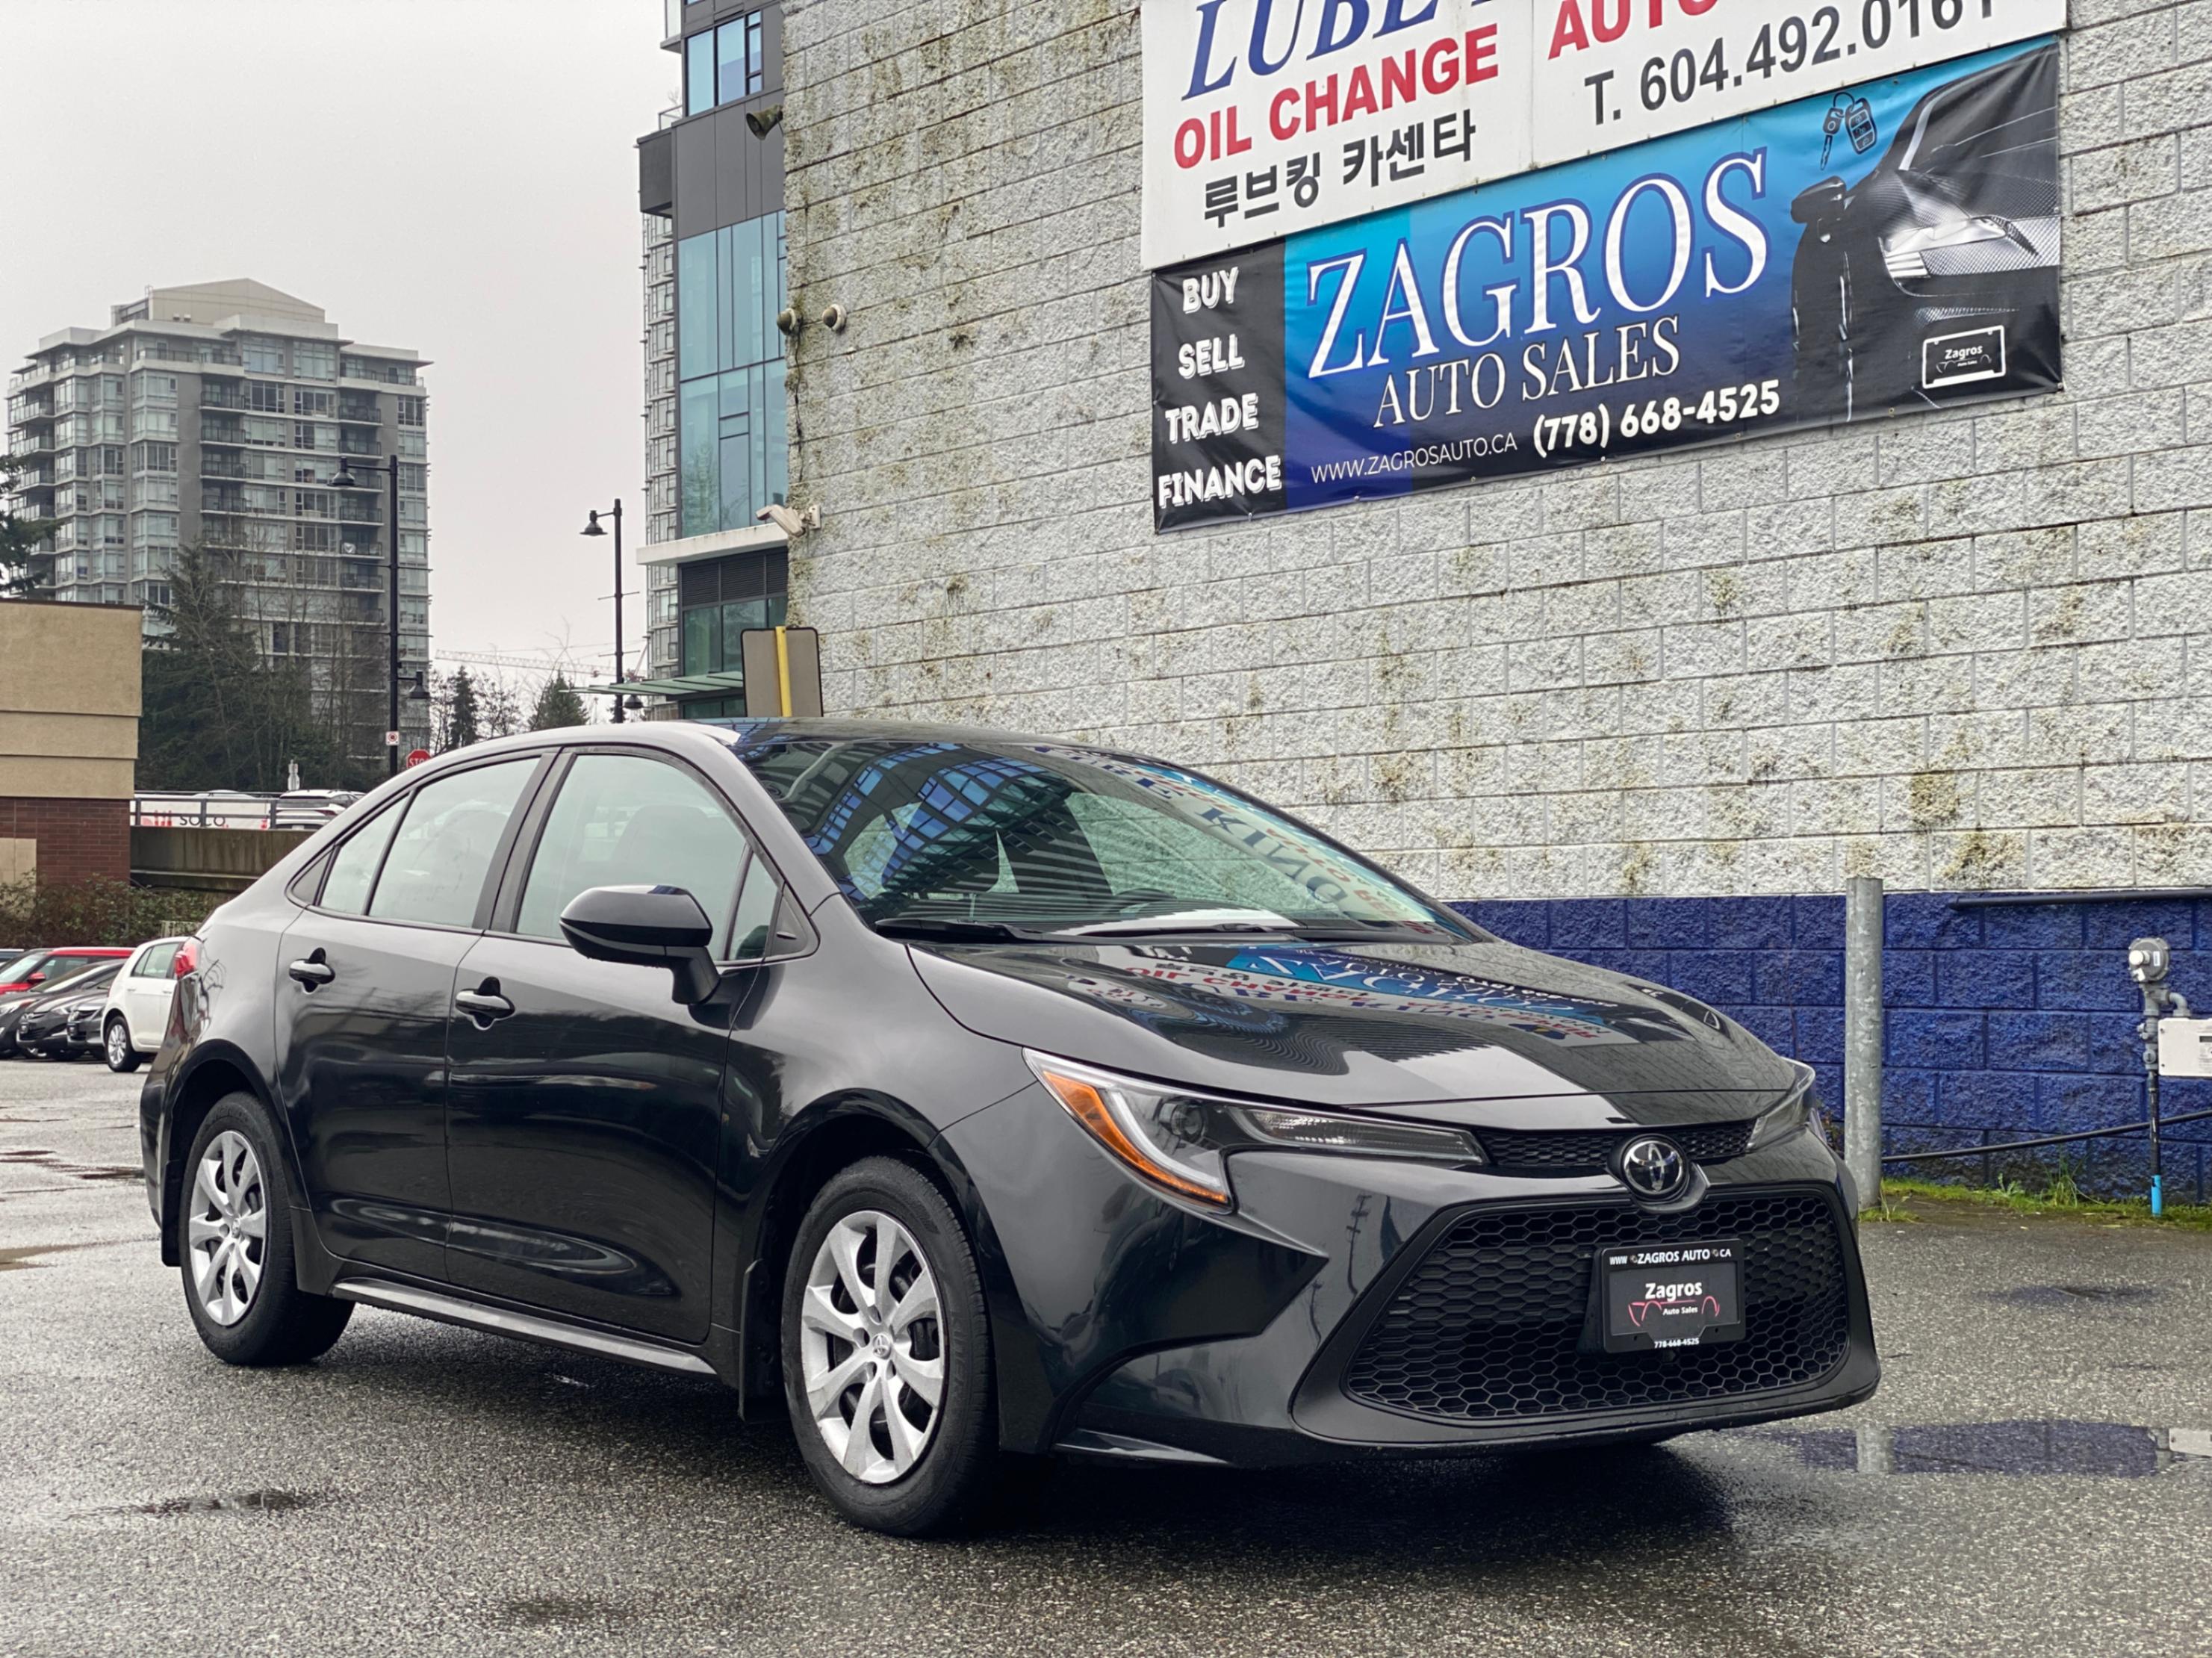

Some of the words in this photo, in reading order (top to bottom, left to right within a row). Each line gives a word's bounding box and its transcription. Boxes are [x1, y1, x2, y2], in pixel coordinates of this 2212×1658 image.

[1547, 0, 1718, 60] AU
[1175, 106, 1252, 169] OIL
[1269, 23, 1499, 140] CHANGE
[1585, 69, 1621, 125] T.
[1205, 152, 1320, 228] 루브킹
[1343, 109, 1476, 187] 카센타
[1182, 267, 1240, 314] BUY
[1307, 149, 1769, 379] ZAGROS
[1178, 334, 1245, 379] SELL
[1373, 353, 1506, 428] AUTO
[1521, 316, 1680, 401] SALES
[1945, 346, 1983, 360] Zagros
[1165, 393, 1259, 444] TRADE
[1533, 403, 1610, 459] (778)
[1620, 379, 1780, 438] 668-4525
[1158, 454, 1282, 508] FINANCE
[1311, 432, 1517, 484] WWW.ZAGROSAUTO.CA
[409, 758, 429, 769] ST
[1637, 1251, 1680, 1264] ZAGROS
[1681, 1249, 1710, 1261] AUTO
[1720, 1249, 1732, 1258] CA
[1645, 1282, 1703, 1302] Zagros
